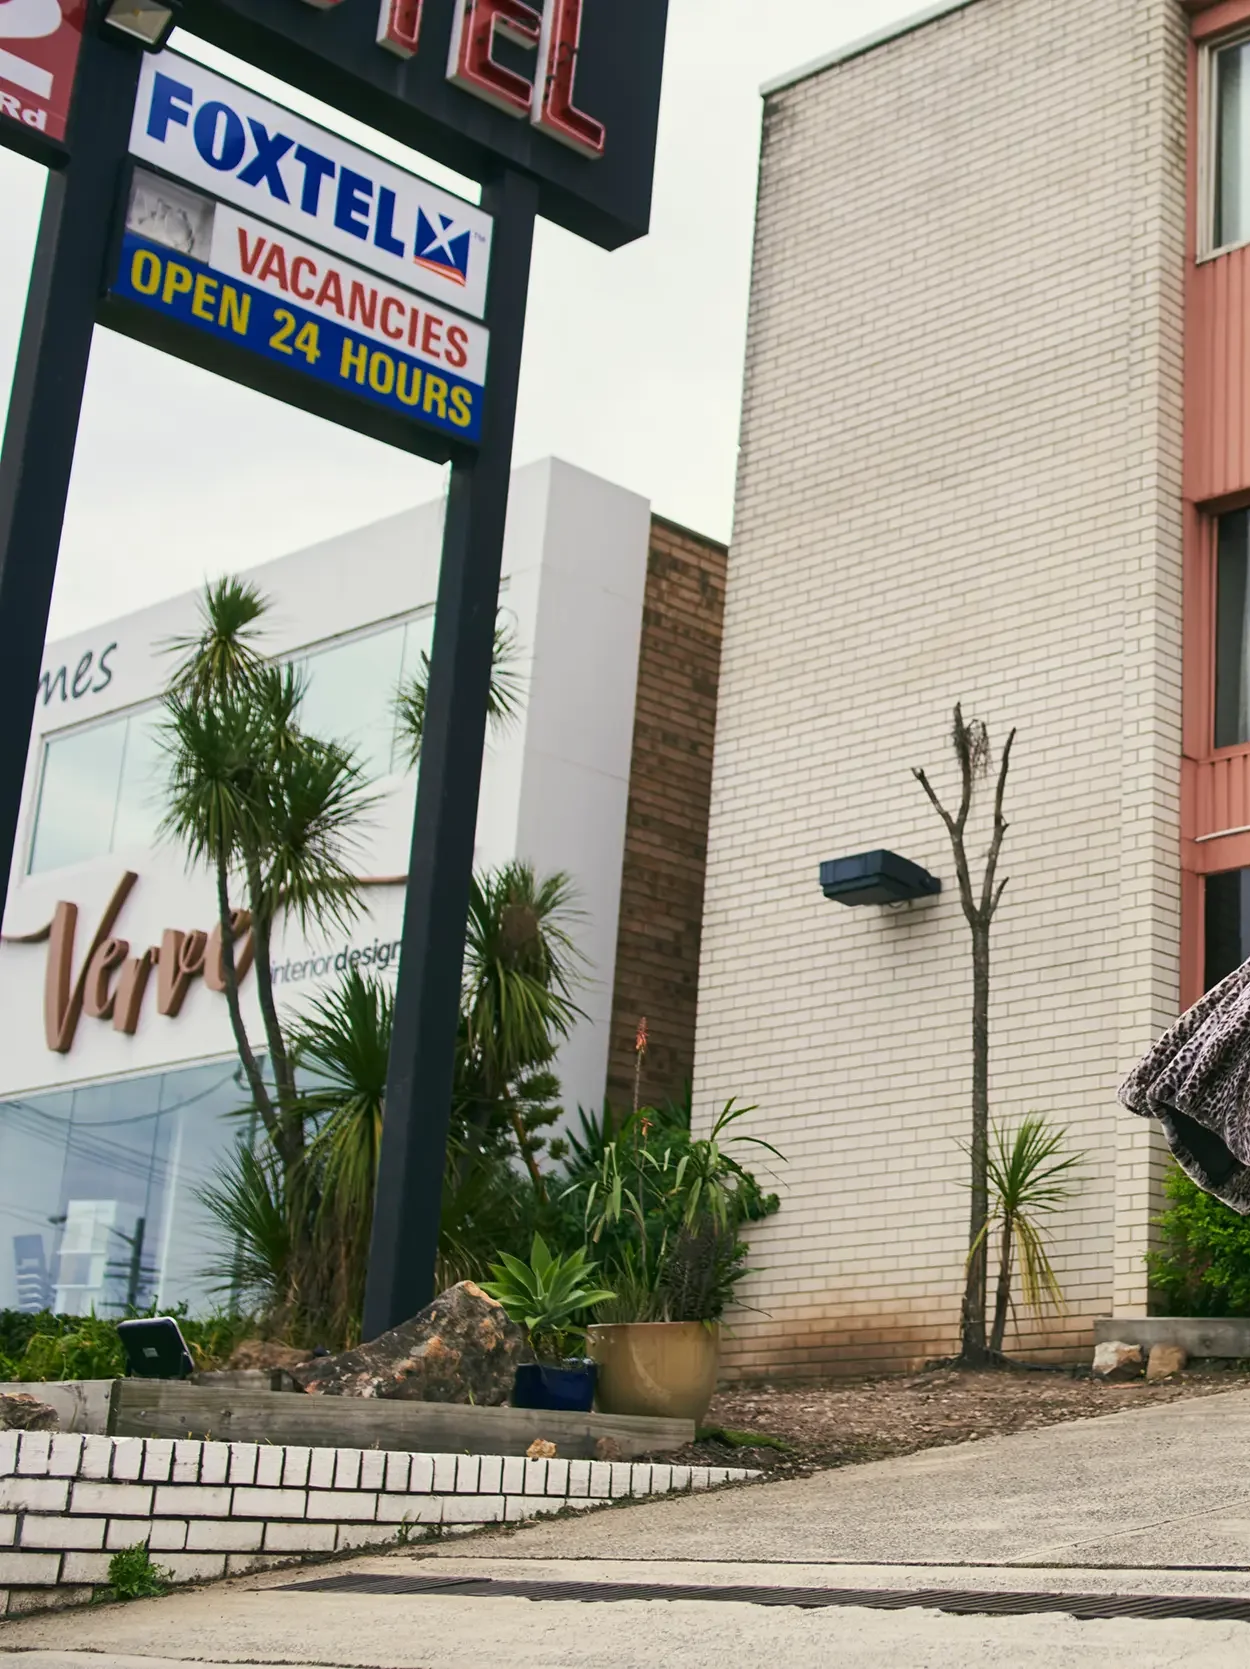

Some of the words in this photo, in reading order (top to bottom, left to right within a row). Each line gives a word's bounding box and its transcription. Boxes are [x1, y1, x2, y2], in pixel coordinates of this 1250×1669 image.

[146, 70, 406, 259] FOXTEL
[130, 248, 252, 336] OPEN
[268, 307, 321, 365] 24
[338, 336, 473, 428] HOURS
[237, 227, 469, 369] VACANCIES
[8, 869, 258, 1055] Verve
